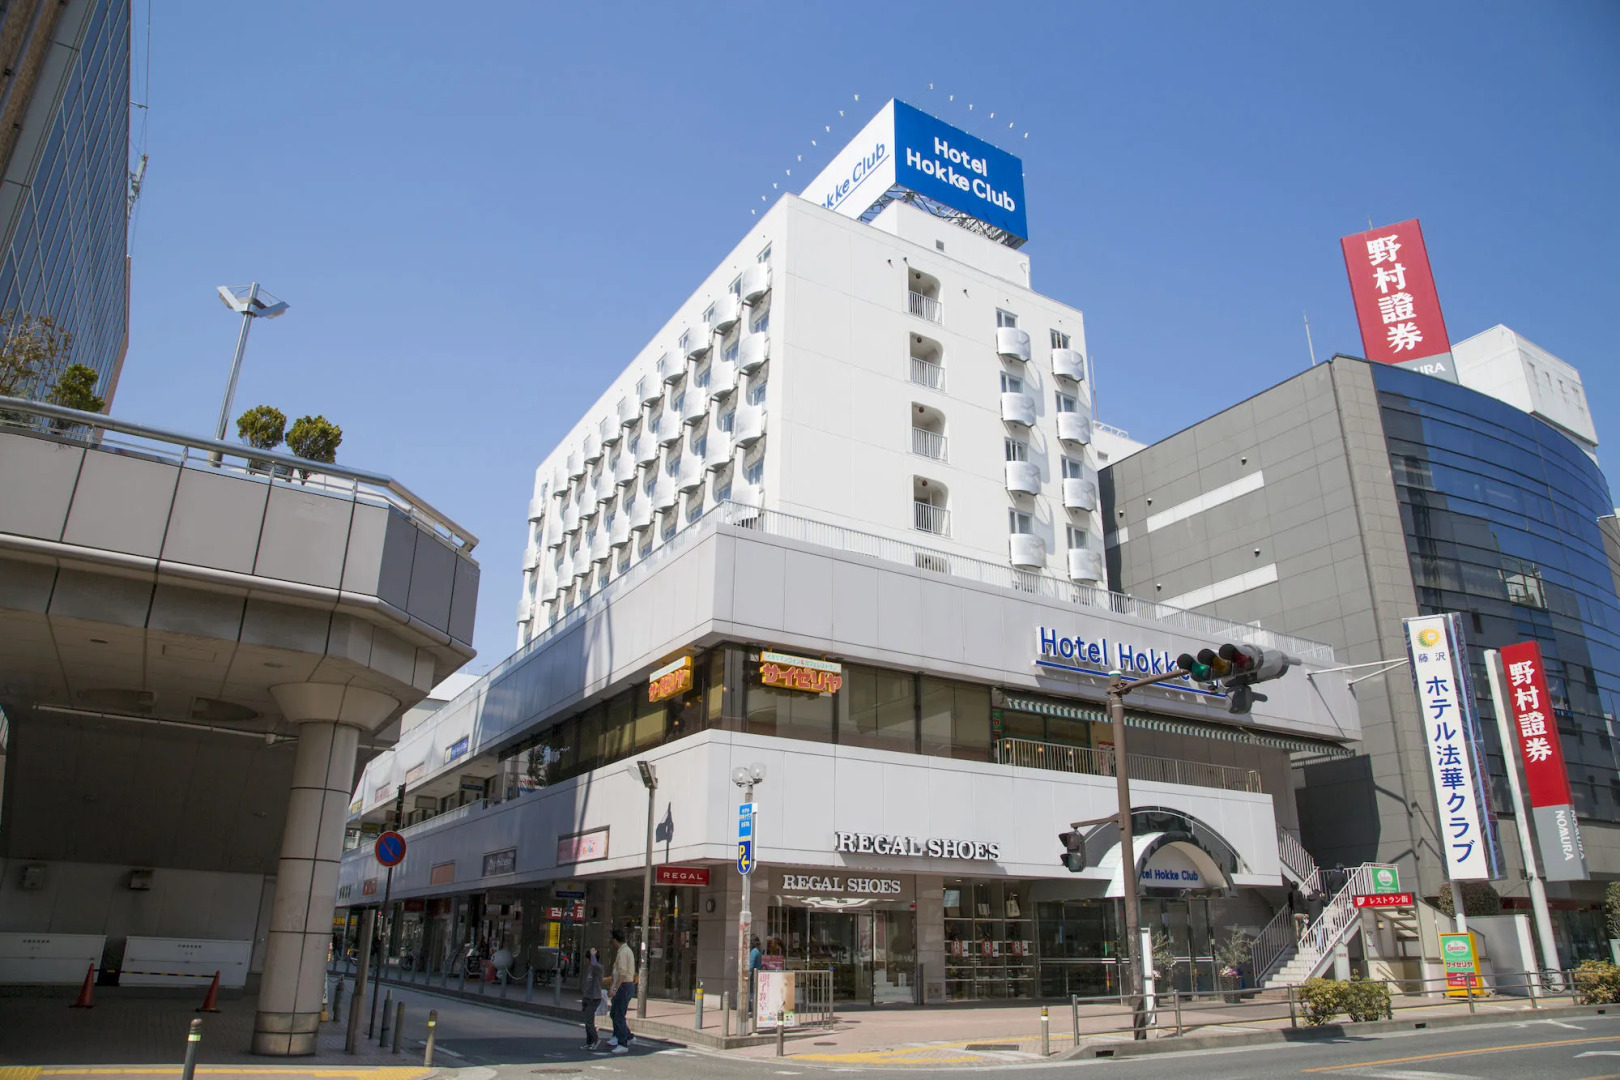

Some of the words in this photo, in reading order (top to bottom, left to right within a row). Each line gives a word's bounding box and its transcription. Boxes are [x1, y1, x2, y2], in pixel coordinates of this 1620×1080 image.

[852, 142, 886, 182] Club
[934, 136, 988, 177] Hotel
[906, 147, 970, 192] Hokke
[973, 178, 1016, 212] Club
[1366, 234, 1424, 353] 野村證券
[1037, 626, 1108, 665] Hotel
[761, 663, 842, 693] サイゼリヤ
[1509, 660, 1553, 763] 野村證券
[1426, 675, 1475, 863] ホテル法華クラブ
[835, 831, 923, 857] REGAL
[926, 837, 1001, 861] SHOES
[1554, 809, 1574, 861] NOMURA
[663, 871, 703, 880] REGAL
[783, 875, 844, 892] REGAL
[847, 878, 901, 894] SHOES
[1154, 869, 1180, 880] Hokke
[1181, 870, 1199, 881] Club
[1368, 895, 1408, 905] レストラン街
